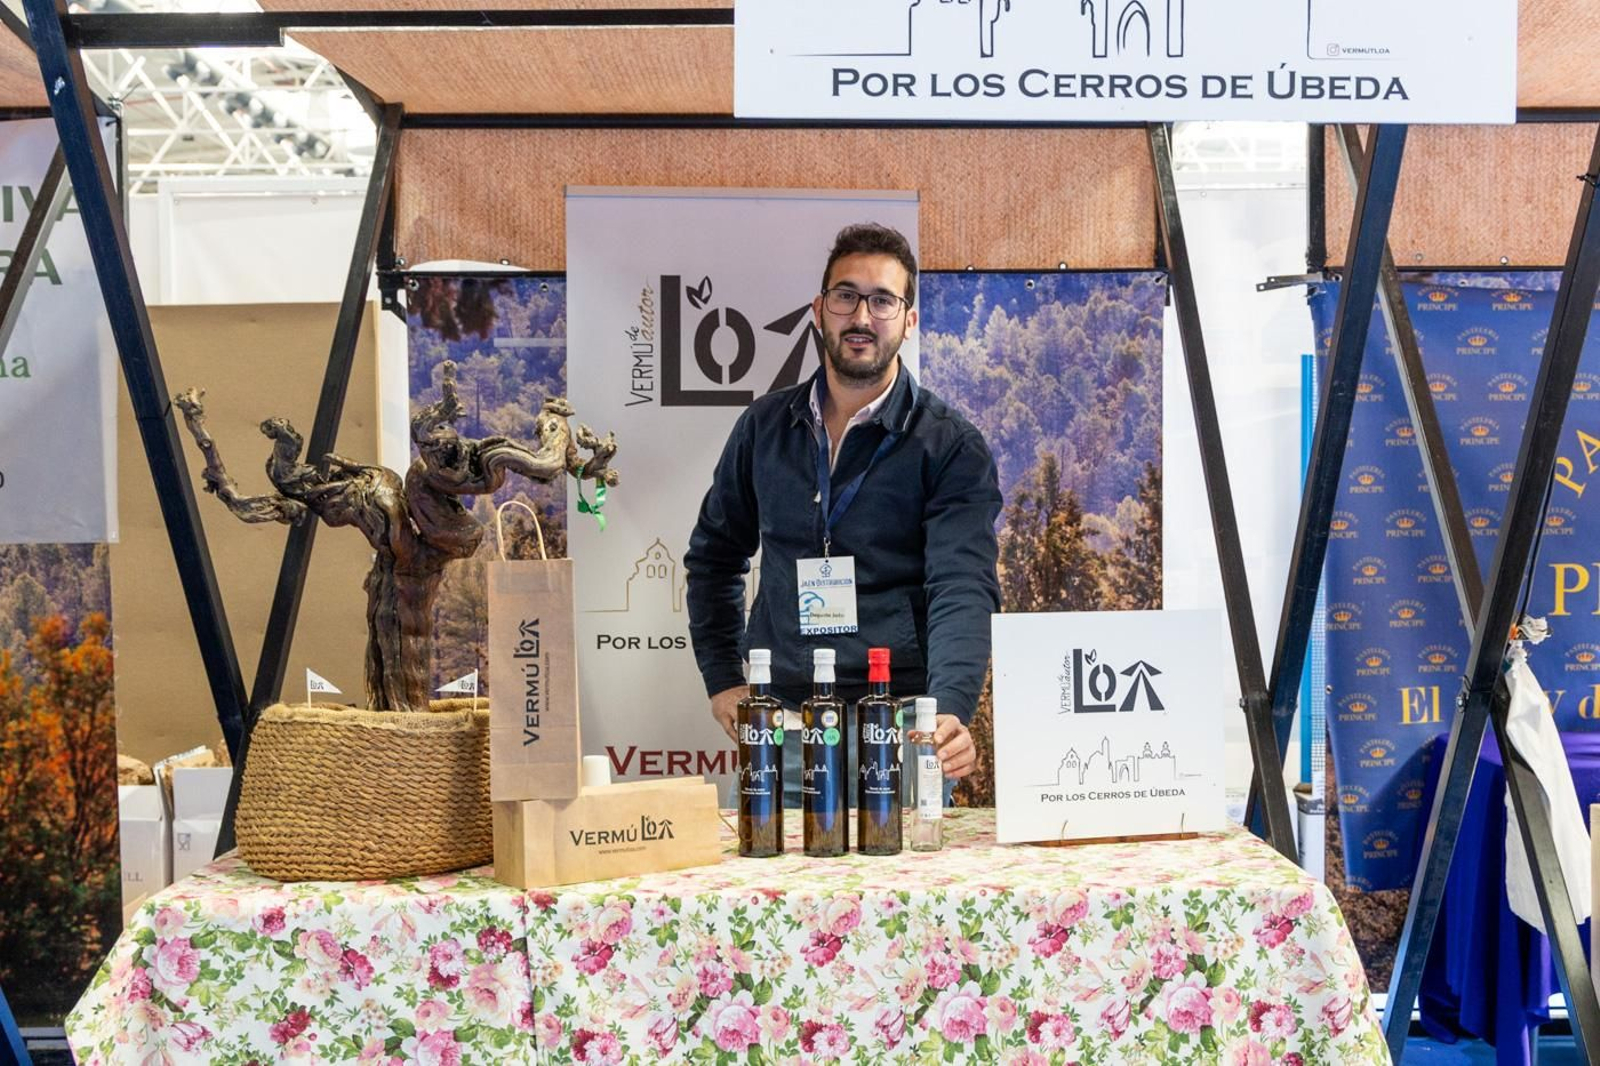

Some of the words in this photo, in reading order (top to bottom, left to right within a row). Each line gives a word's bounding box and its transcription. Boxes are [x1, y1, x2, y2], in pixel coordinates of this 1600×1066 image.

[831, 67, 916, 97] POR
[930, 72, 1005, 97] LOS
[1017, 68, 1188, 98] CERROS
[1201, 75, 1253, 98] DE
[1266, 62, 1410, 100] ÚBEDA
[597, 634, 640, 650] POR
[648, 635, 687, 650] LOS
[1073, 649, 1165, 713] LOA
[521, 663, 540, 747] VERMÚ
[1398, 685, 1444, 725] El
[1041, 793, 1063, 803] POR
[1066, 793, 1086, 802] LOS
[1088, 791, 1131, 801] CERROS
[1133, 789, 1148, 799] DE
[1150, 786, 1186, 798] ÚBEDA
[569, 824, 637, 846] VERMÚ
